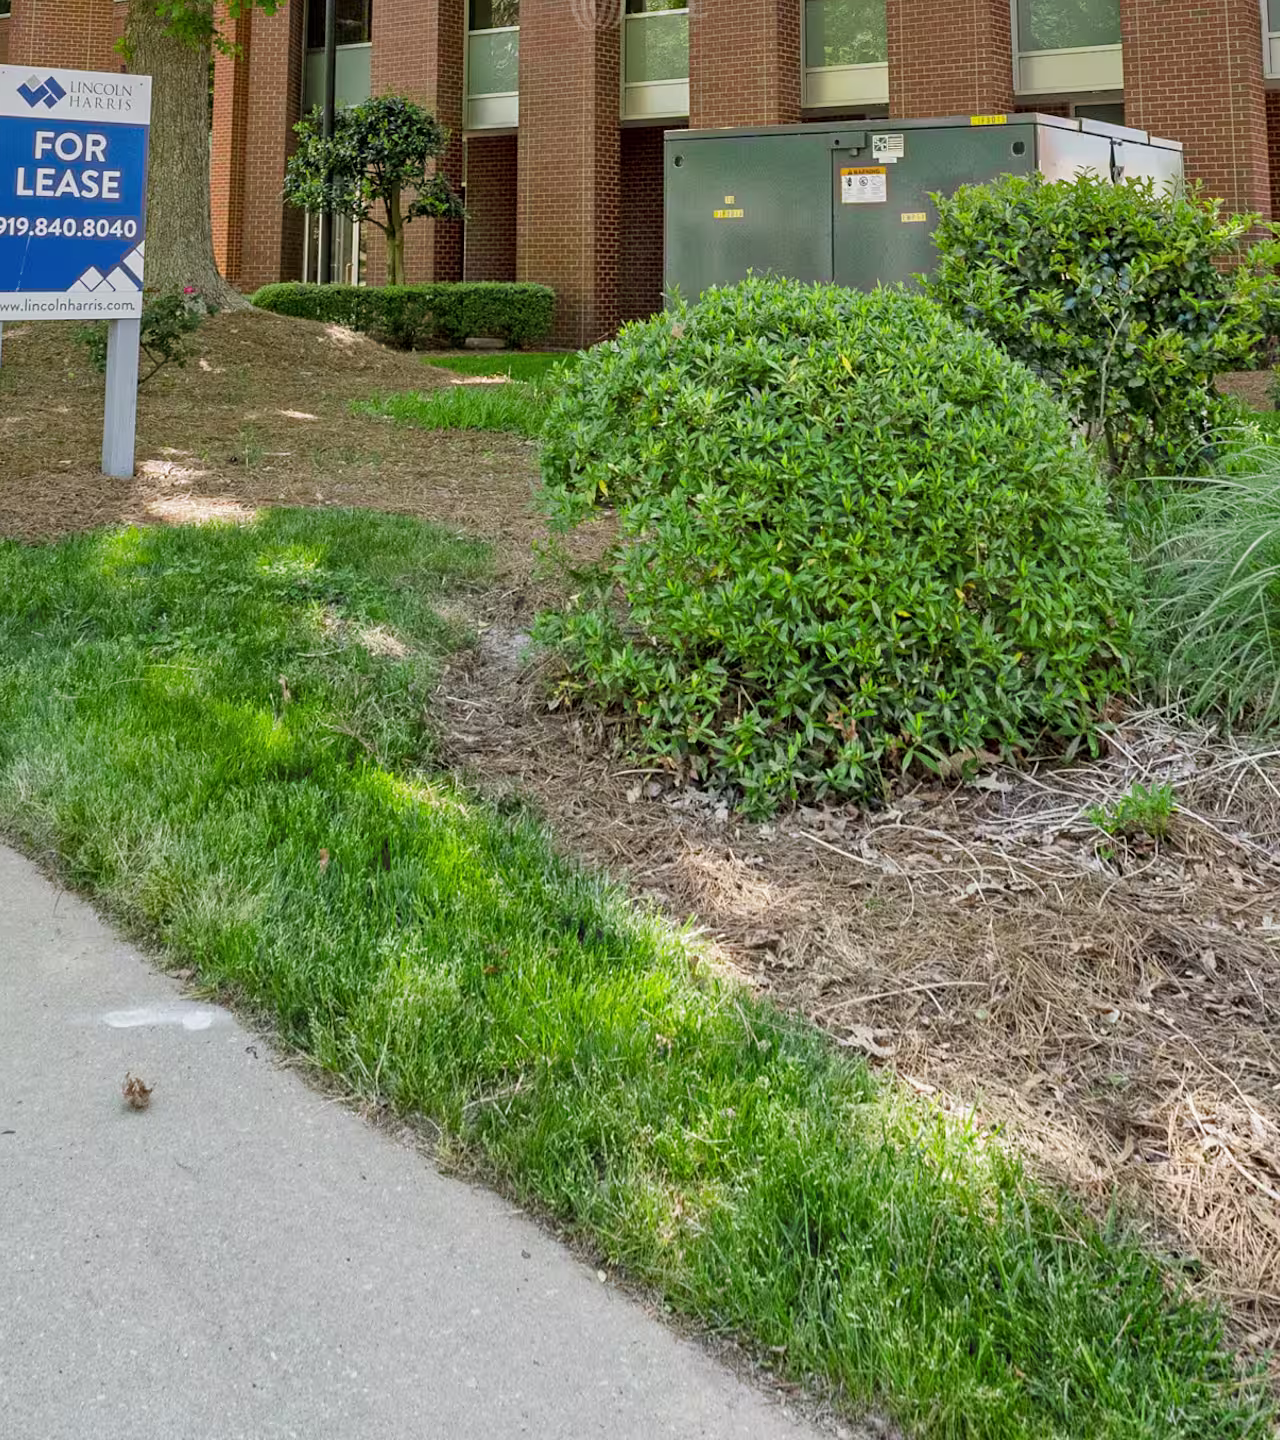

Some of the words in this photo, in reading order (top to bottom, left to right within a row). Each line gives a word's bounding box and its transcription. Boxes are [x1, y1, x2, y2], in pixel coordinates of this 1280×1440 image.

[70, 81, 133, 97] LINCOLN
[69, 95, 133, 111] HARRIS
[34, 130, 108, 163] FOR
[16, 167, 121, 199] LEASE
